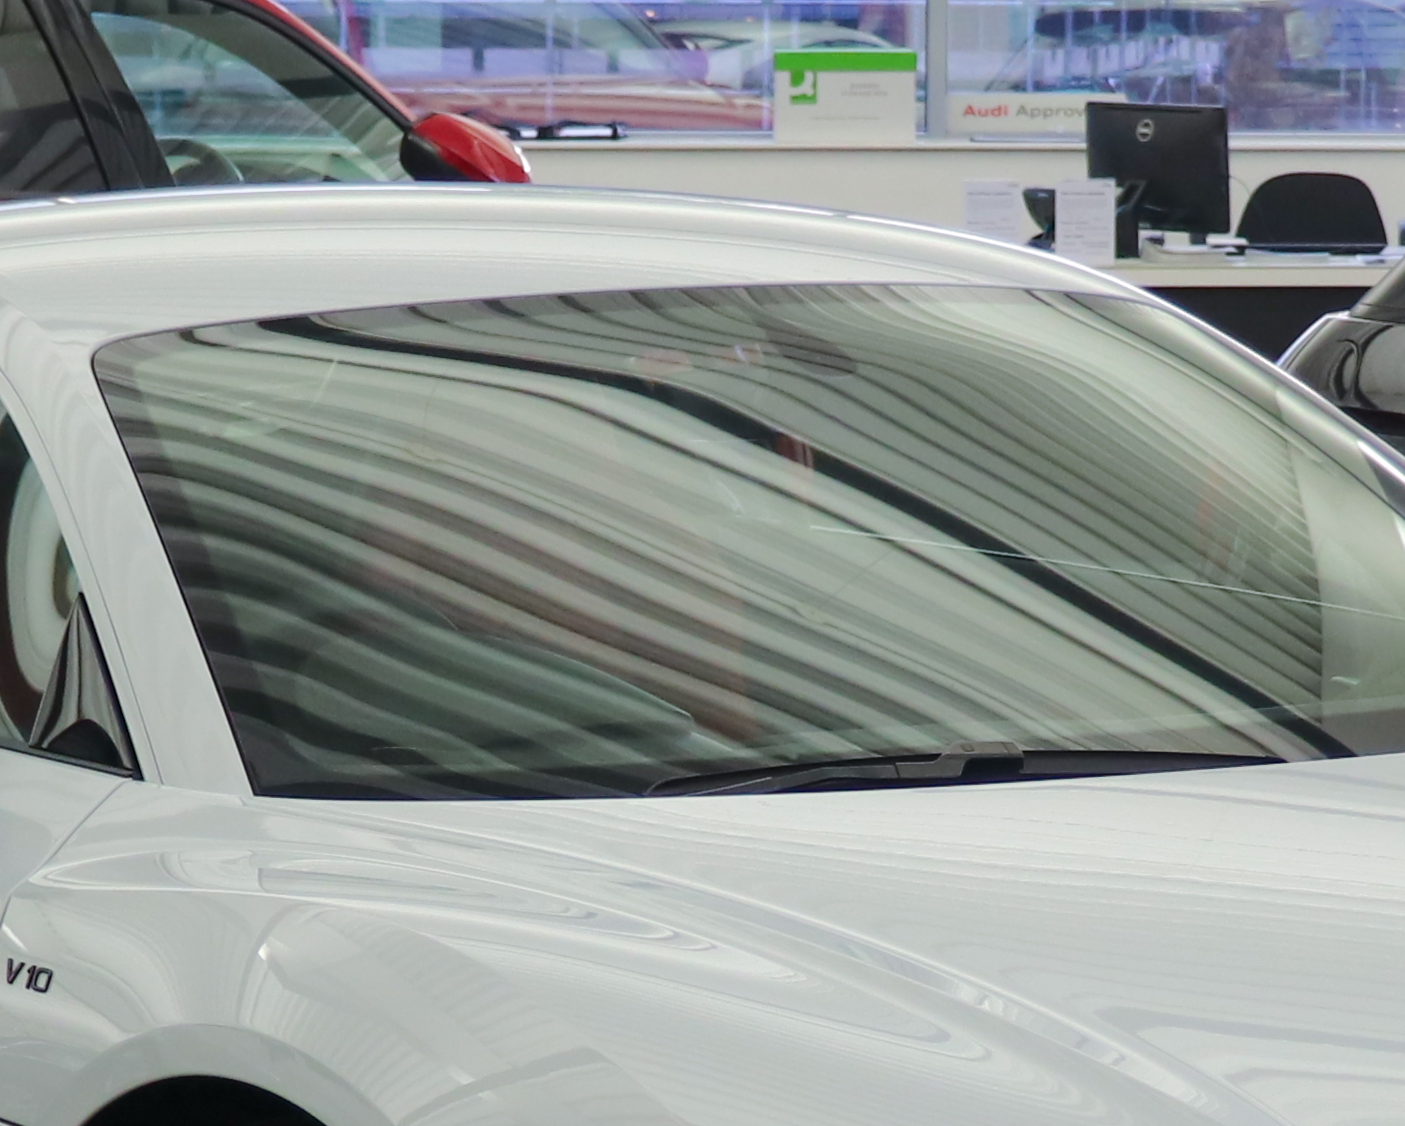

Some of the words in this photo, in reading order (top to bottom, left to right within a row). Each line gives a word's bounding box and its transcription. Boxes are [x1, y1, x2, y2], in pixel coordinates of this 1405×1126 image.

[962, 104, 1008, 117] Audi
[1015, 104, 1086, 119] Approv
[6, 957, 54, 994] V10
